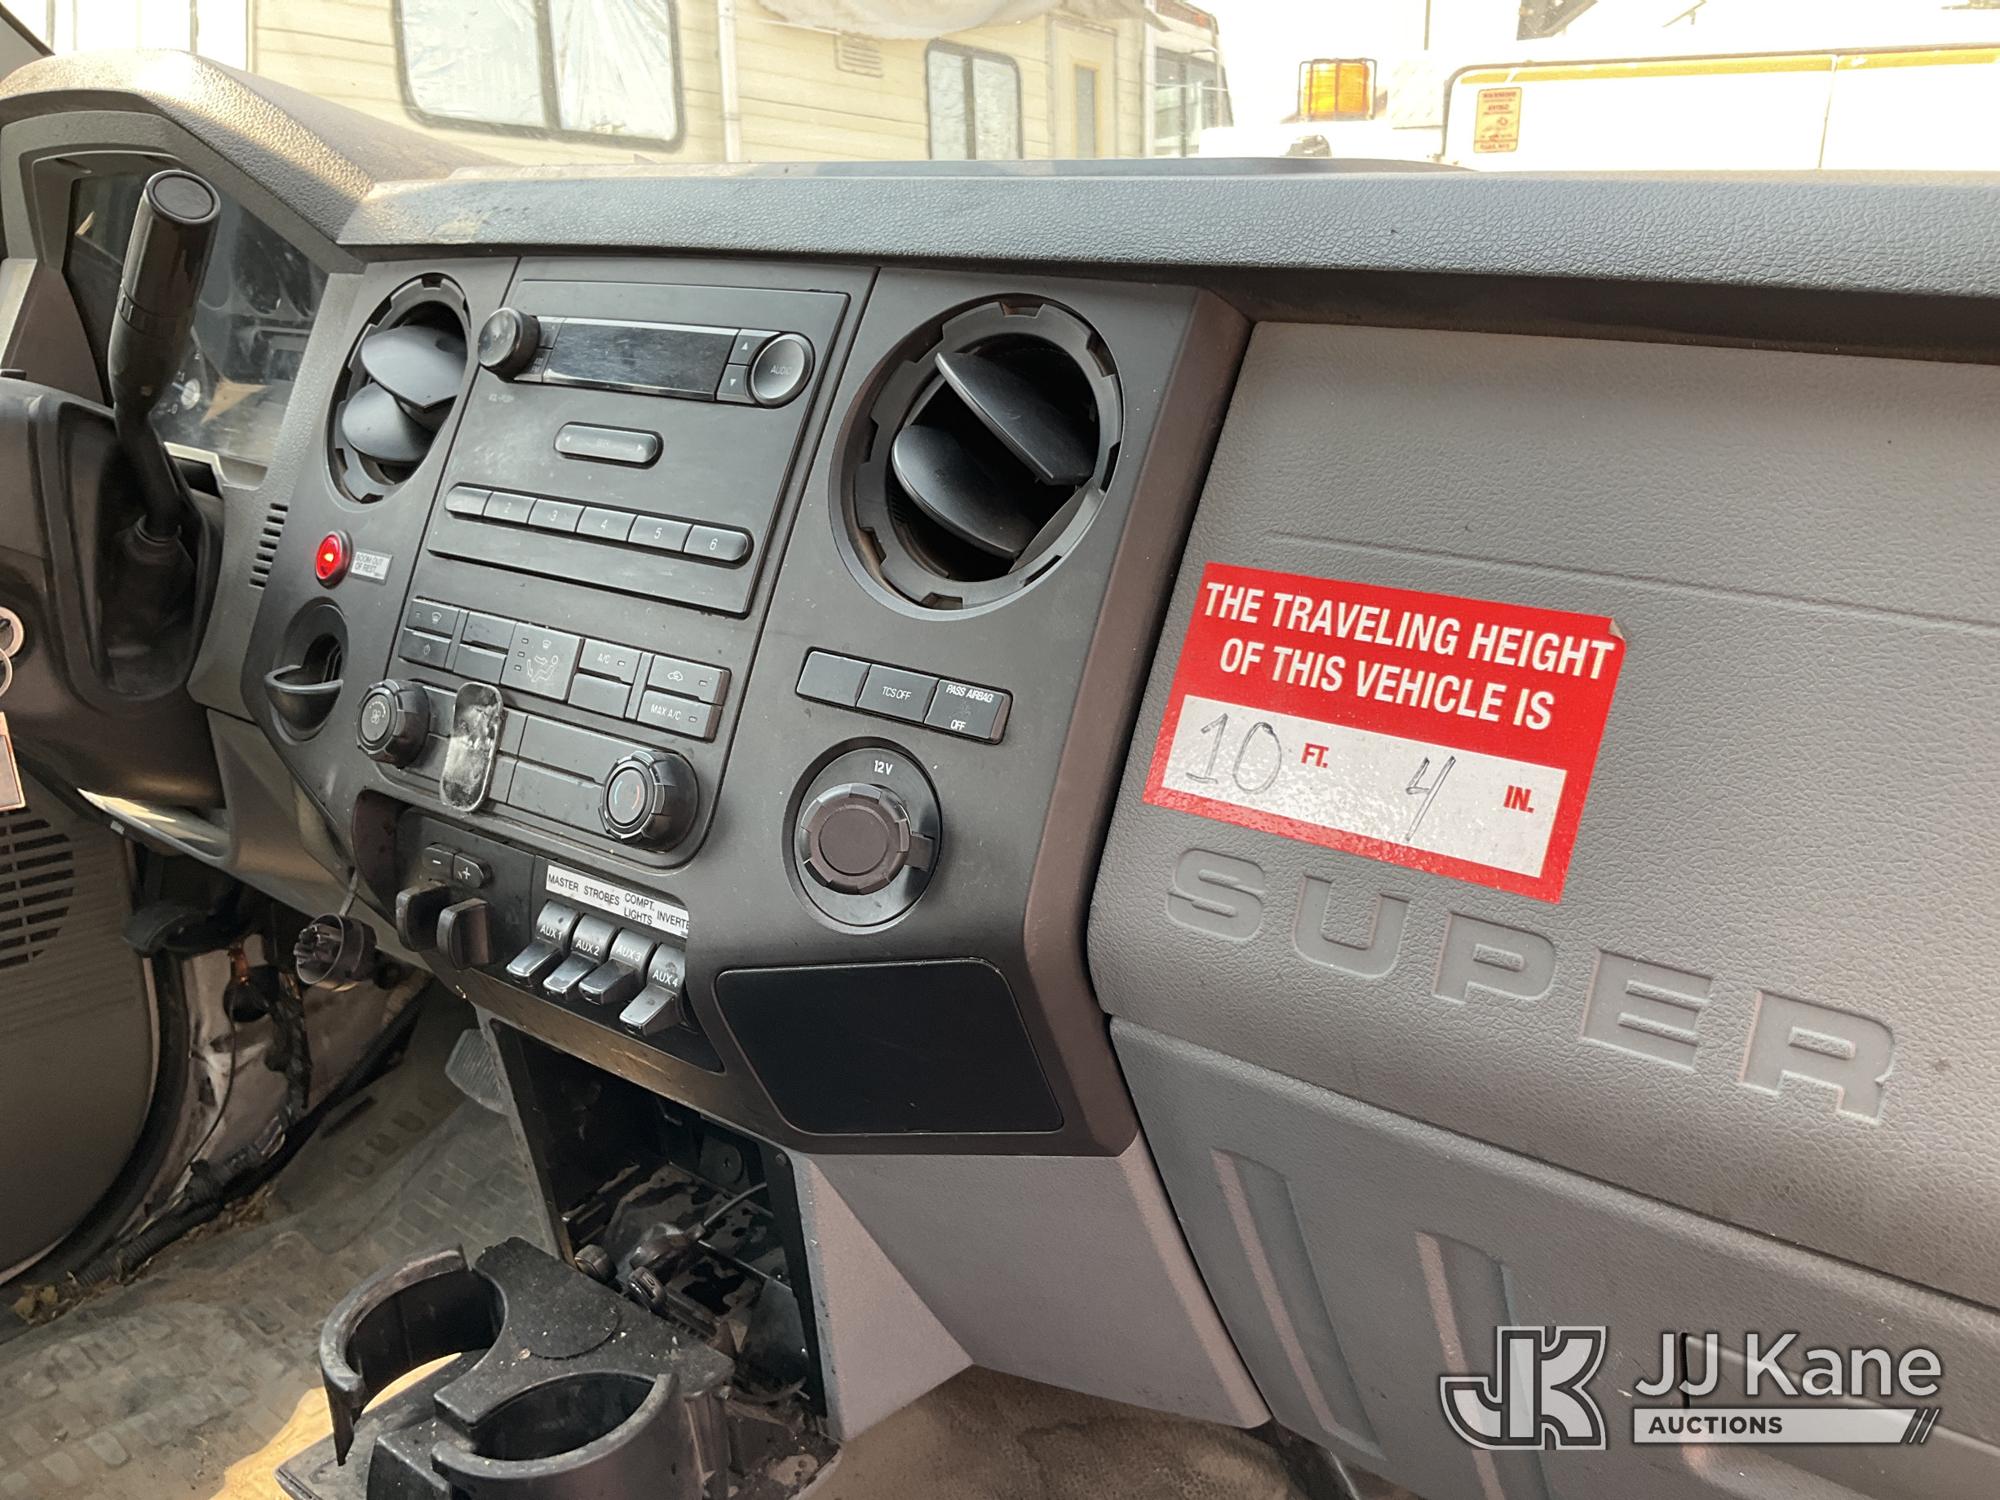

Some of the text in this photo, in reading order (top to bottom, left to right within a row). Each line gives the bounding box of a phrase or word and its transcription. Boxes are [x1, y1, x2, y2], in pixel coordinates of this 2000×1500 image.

[504, 502, 511, 513] 2
[550, 510, 558, 522] 3
[600, 518, 608, 530] 4
[654, 528, 662, 540] 5
[709, 538, 718, 551] 6
[1204, 582, 1616, 681] THE TRAVELING HEIGHT
[597, 653, 611, 664] A/C
[1220, 638, 1554, 731] OF THIS VEHICLE IS
[882, 686, 912, 701] TCS OFF
[946, 685, 994, 703] PASS AIRBAG
[650, 704, 682, 721] MAX A/C
[950, 719, 966, 731] OFF
[1185, 712, 1283, 794] 10
[1300, 742, 1330, 769] FT.
[874, 760, 893, 776] 12V
[1405, 755, 1457, 842] 4
[1503, 785, 1536, 815] IN.
[548, 873, 579, 892] MASTER
[583, 885, 620, 906] STROBES
[624, 892, 655, 912] COMPT.
[623, 907, 653, 925] LIGHTS
[539, 924, 556, 940] AUX
[575, 939, 593, 953] AUX
[616, 943, 634, 960] AUX
[652, 969, 669, 985] AUX
[1165, 847, 1897, 1126] SUPER
